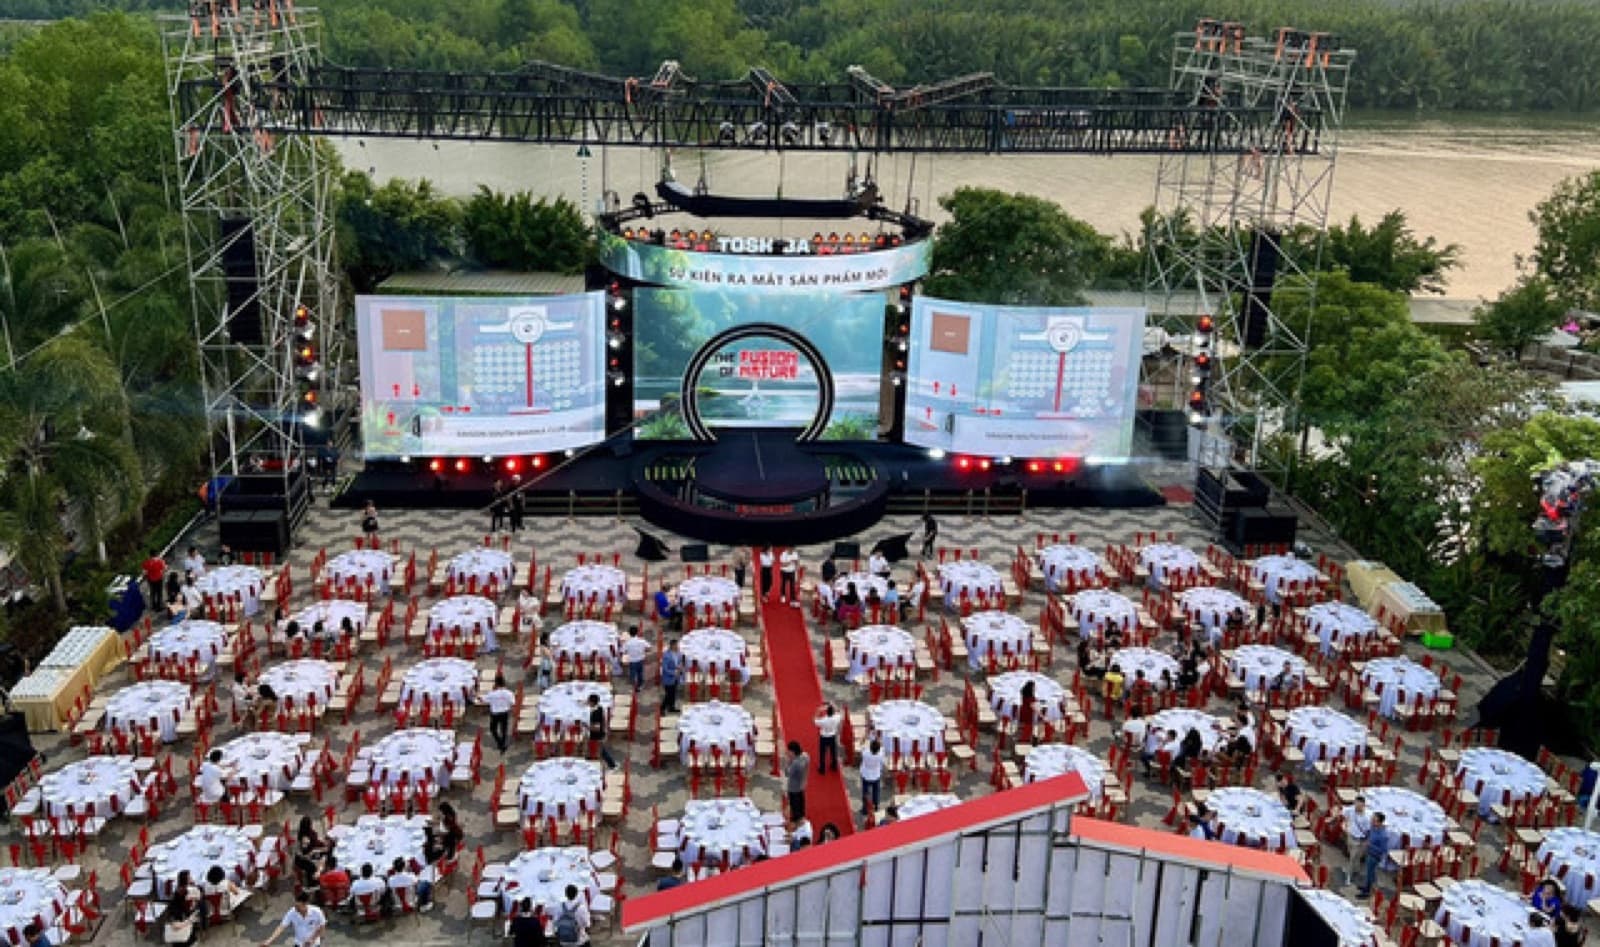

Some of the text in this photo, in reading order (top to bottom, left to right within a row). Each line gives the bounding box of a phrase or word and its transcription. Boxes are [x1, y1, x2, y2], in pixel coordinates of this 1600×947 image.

[717, 236, 811, 253] TOSHBA
[727, 272, 747, 285] RA
[739, 350, 799, 365] FUSION
[739, 365, 799, 380] NATURE
